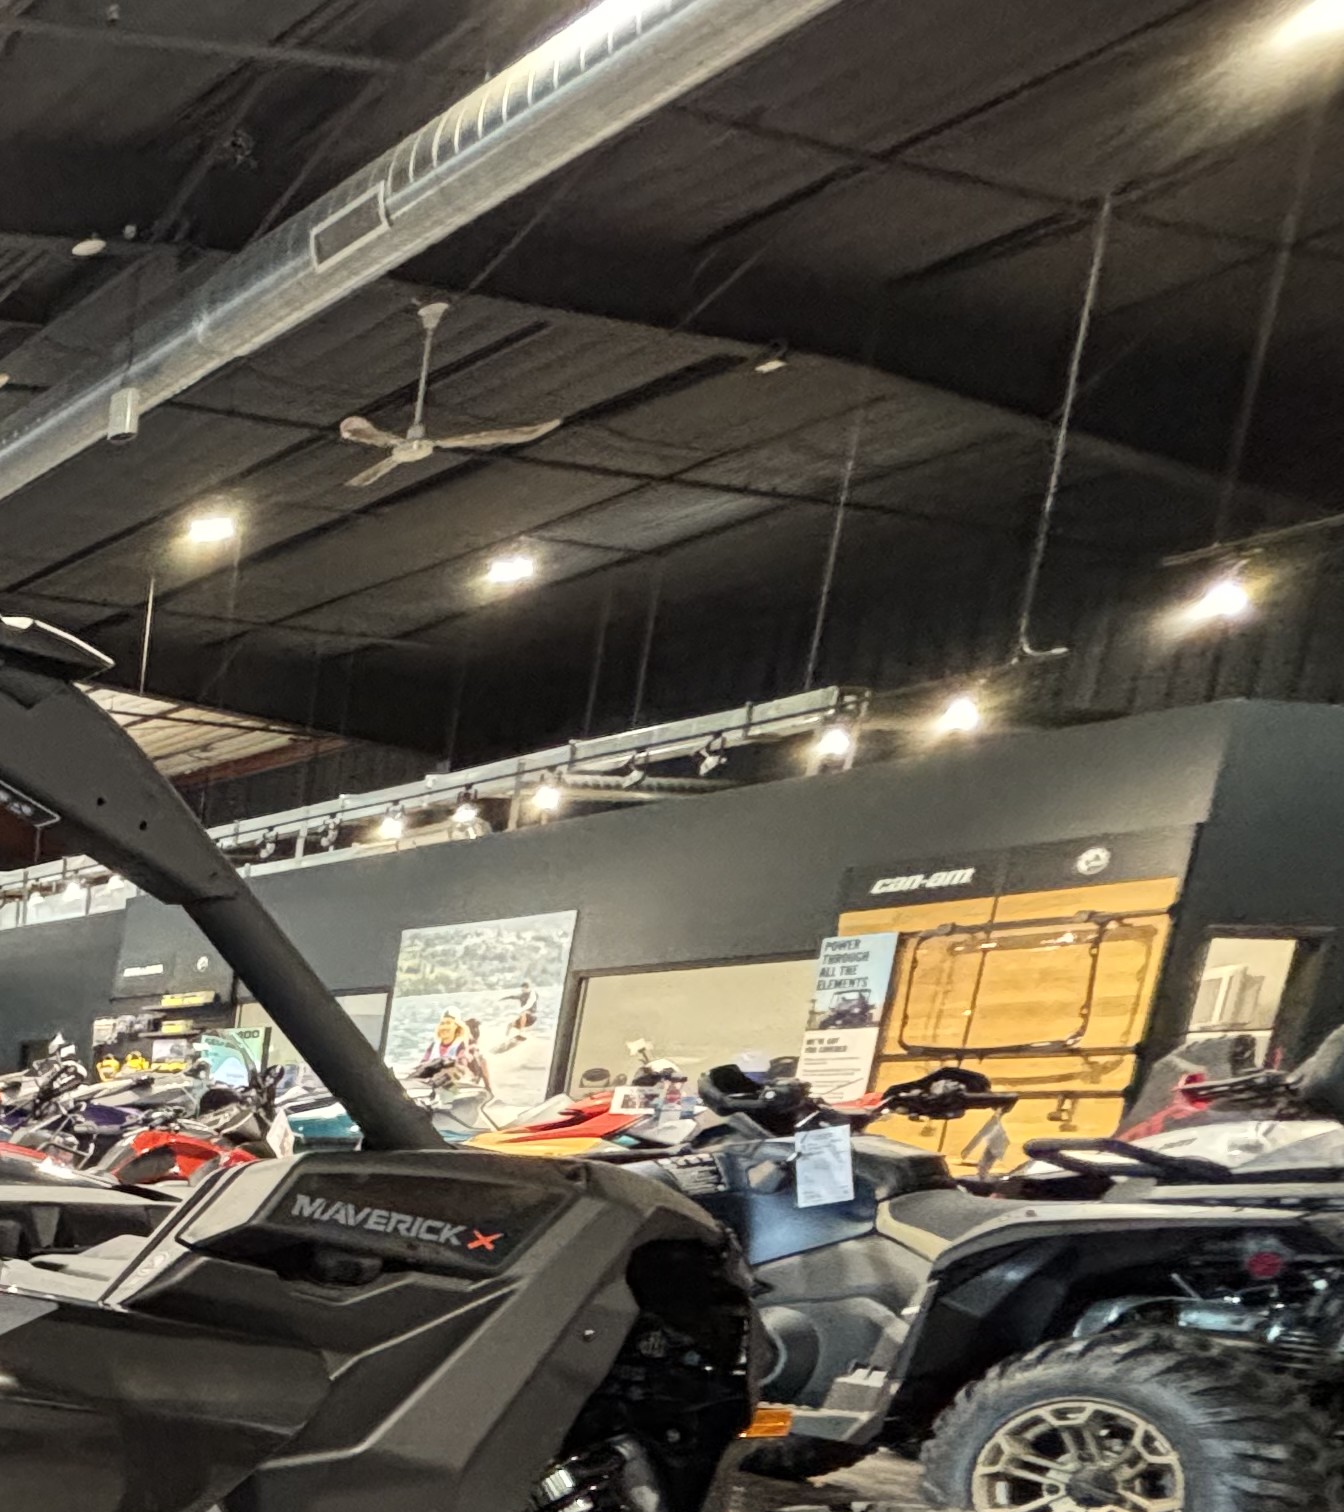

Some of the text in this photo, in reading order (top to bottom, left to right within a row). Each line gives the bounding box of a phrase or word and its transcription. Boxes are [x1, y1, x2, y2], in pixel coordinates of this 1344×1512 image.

[870, 867, 975, 894] can-am
[824, 939, 861, 951] POWER
[822, 951, 870, 965] THROUGH
[819, 965, 859, 977] ALL THE
[816, 977, 869, 991] ELEMENTS
[291, 1193, 504, 1250] MAVERICK X
